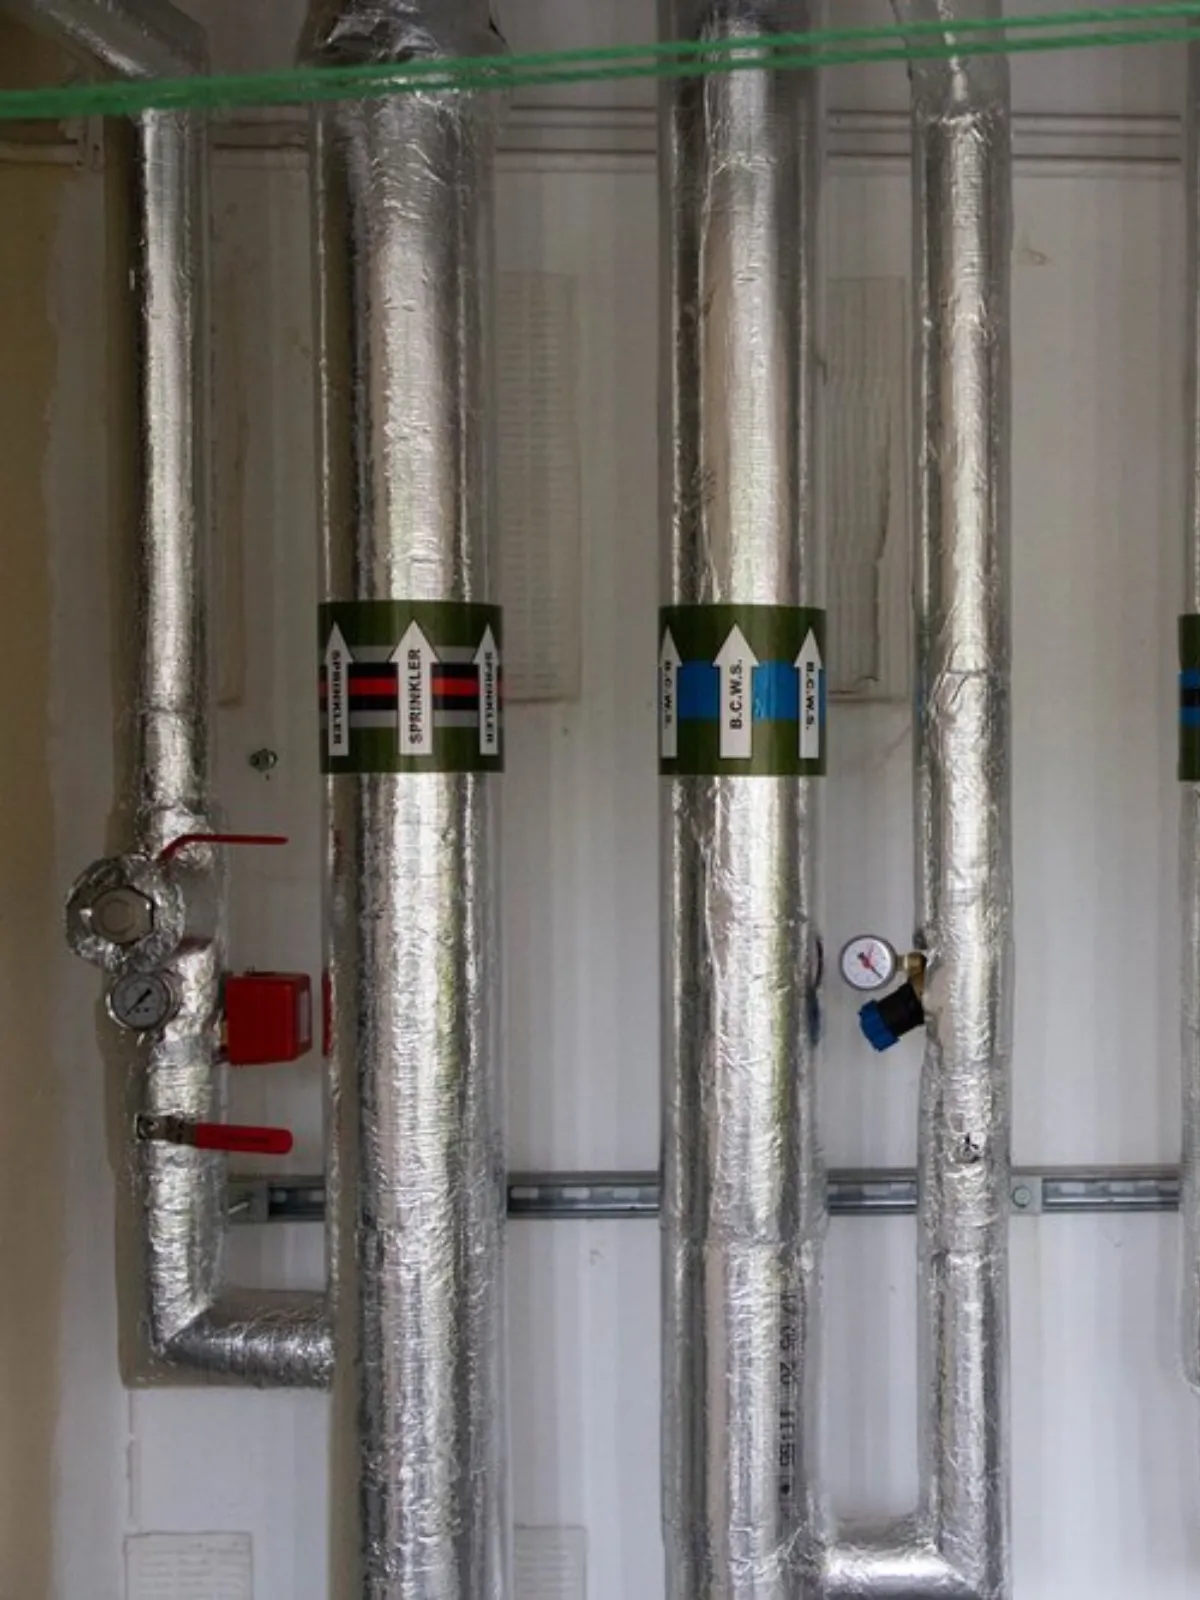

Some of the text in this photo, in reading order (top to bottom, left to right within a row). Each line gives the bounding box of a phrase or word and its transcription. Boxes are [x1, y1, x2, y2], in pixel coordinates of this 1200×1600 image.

[331, 650, 342, 745] SPRINKLER
[407, 649, 423, 744] SPRINKLER
[729, 659, 743, 730] B.C.W.S.
[806, 661, 815, 730] B.C.W.S.
